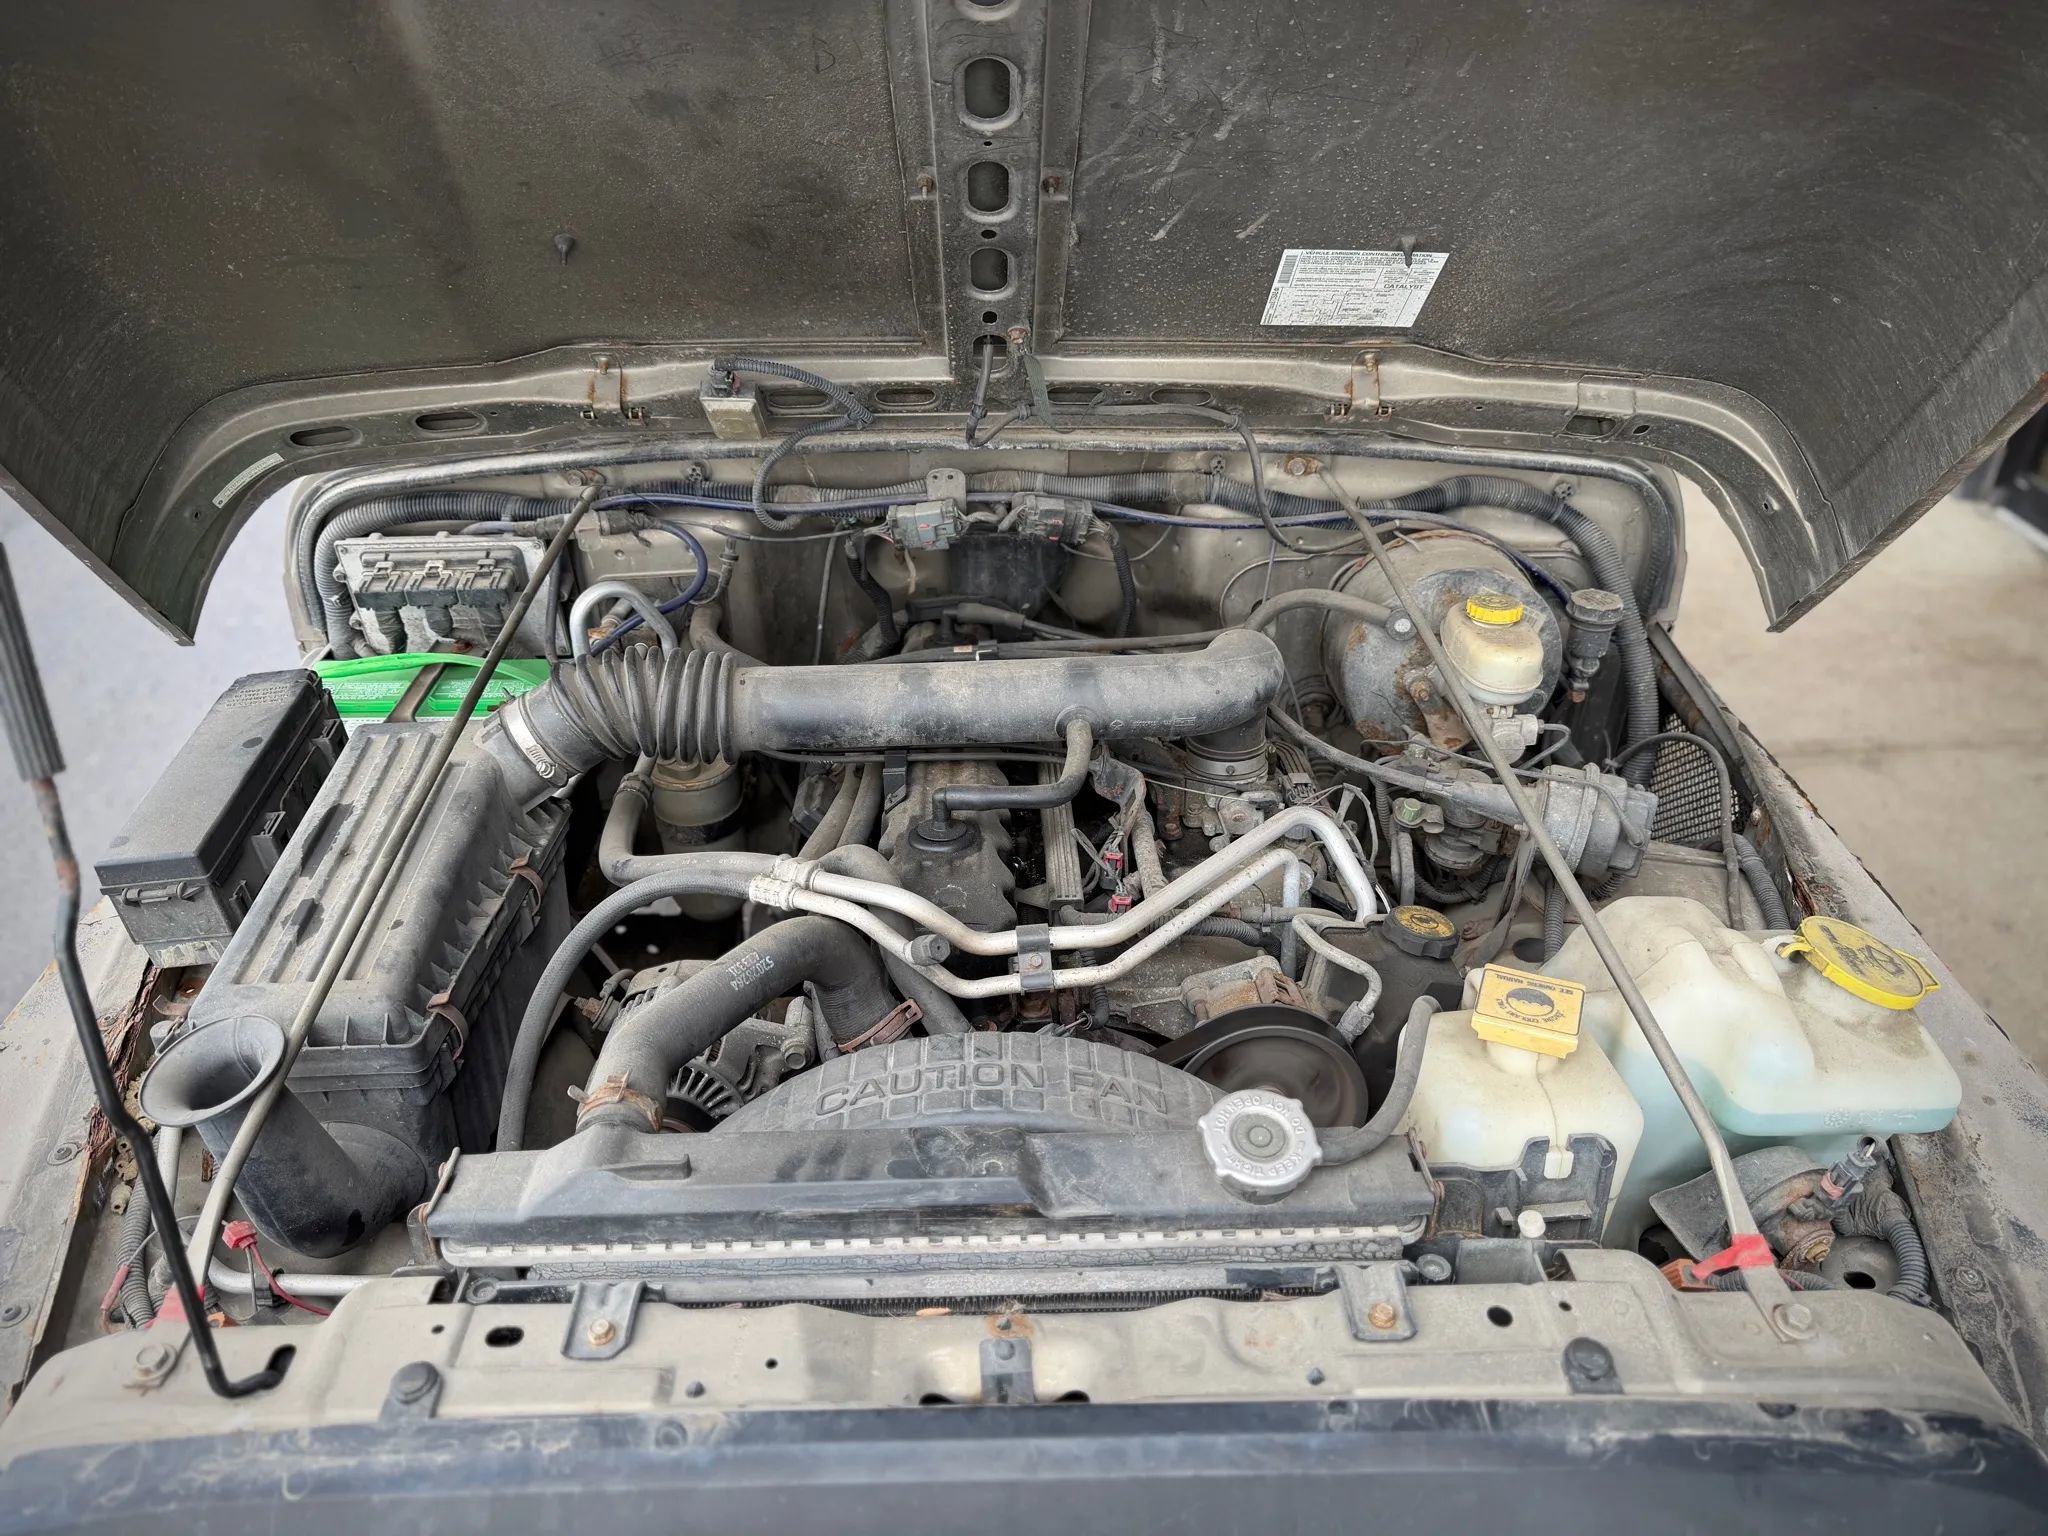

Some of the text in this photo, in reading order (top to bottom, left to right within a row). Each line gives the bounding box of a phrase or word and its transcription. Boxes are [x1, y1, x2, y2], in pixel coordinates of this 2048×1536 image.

[1496, 973, 1524, 984] MANUAL
[815, 1062, 1169, 1117] CAUTION FAN
[1214, 1095, 1306, 1135] DO NOT OPEN HOT
[1226, 1151, 1304, 1178] KEEP TIGHT
